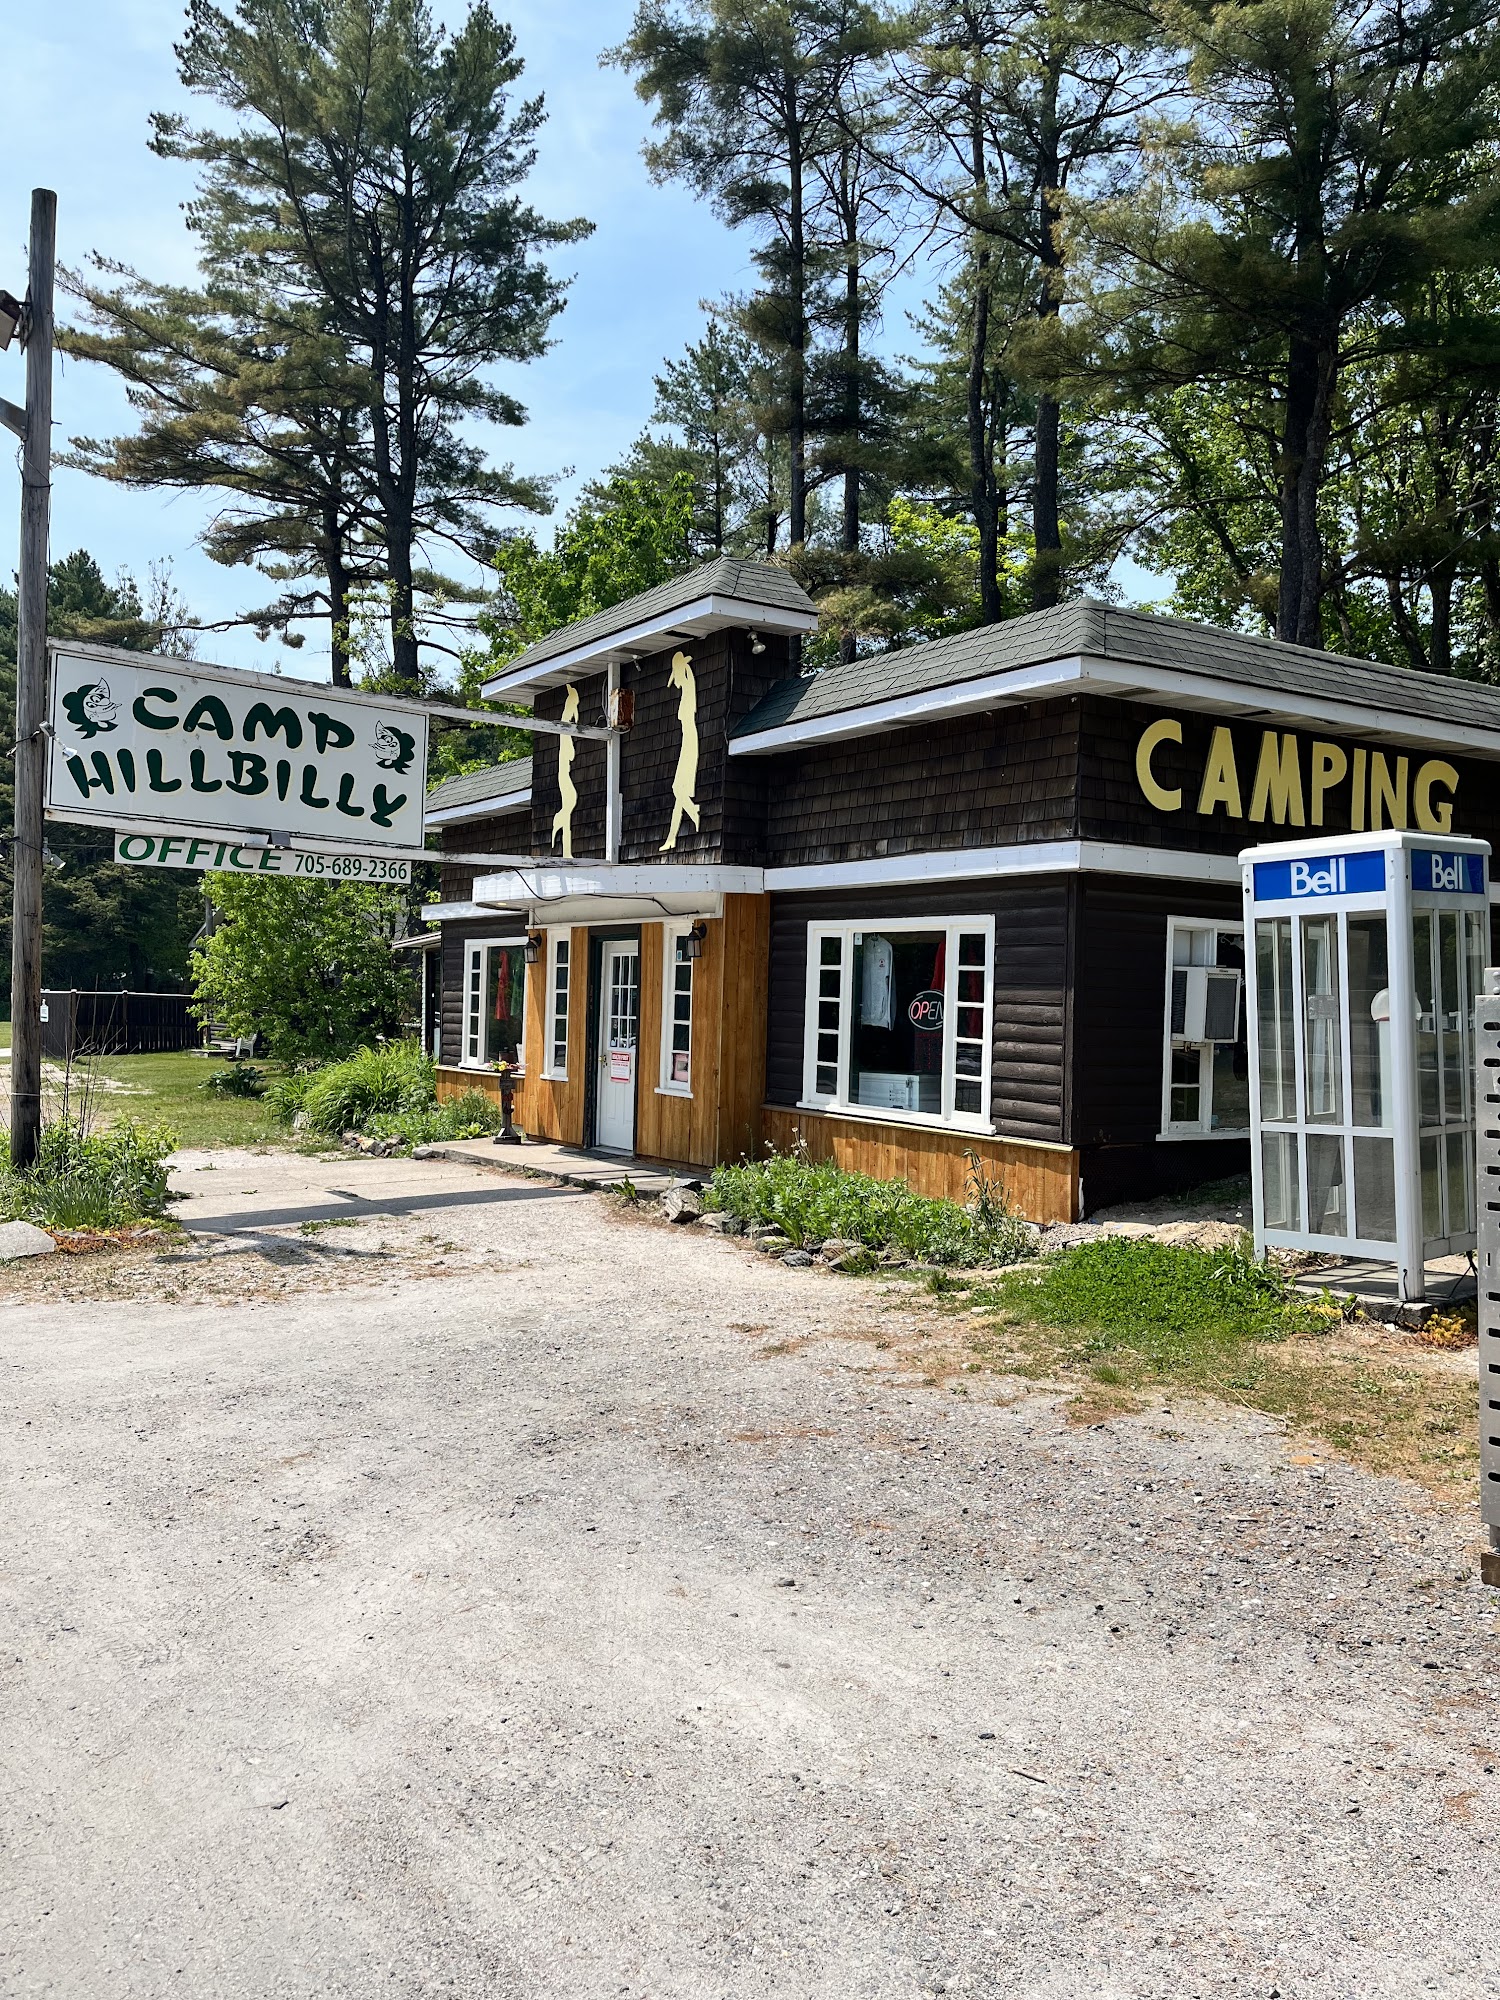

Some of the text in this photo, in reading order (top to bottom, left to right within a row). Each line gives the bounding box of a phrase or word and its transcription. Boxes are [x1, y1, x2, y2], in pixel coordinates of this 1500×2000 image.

[132, 687, 355, 754] CAMP
[66, 748, 407, 828] HILLBILLY
[1136, 718, 1459, 833] CAMPING
[118, 834, 408, 881] OFFICE 705-689-2366
[1290, 857, 1347, 896] Bell
[1431, 854, 1463, 890] Bell
